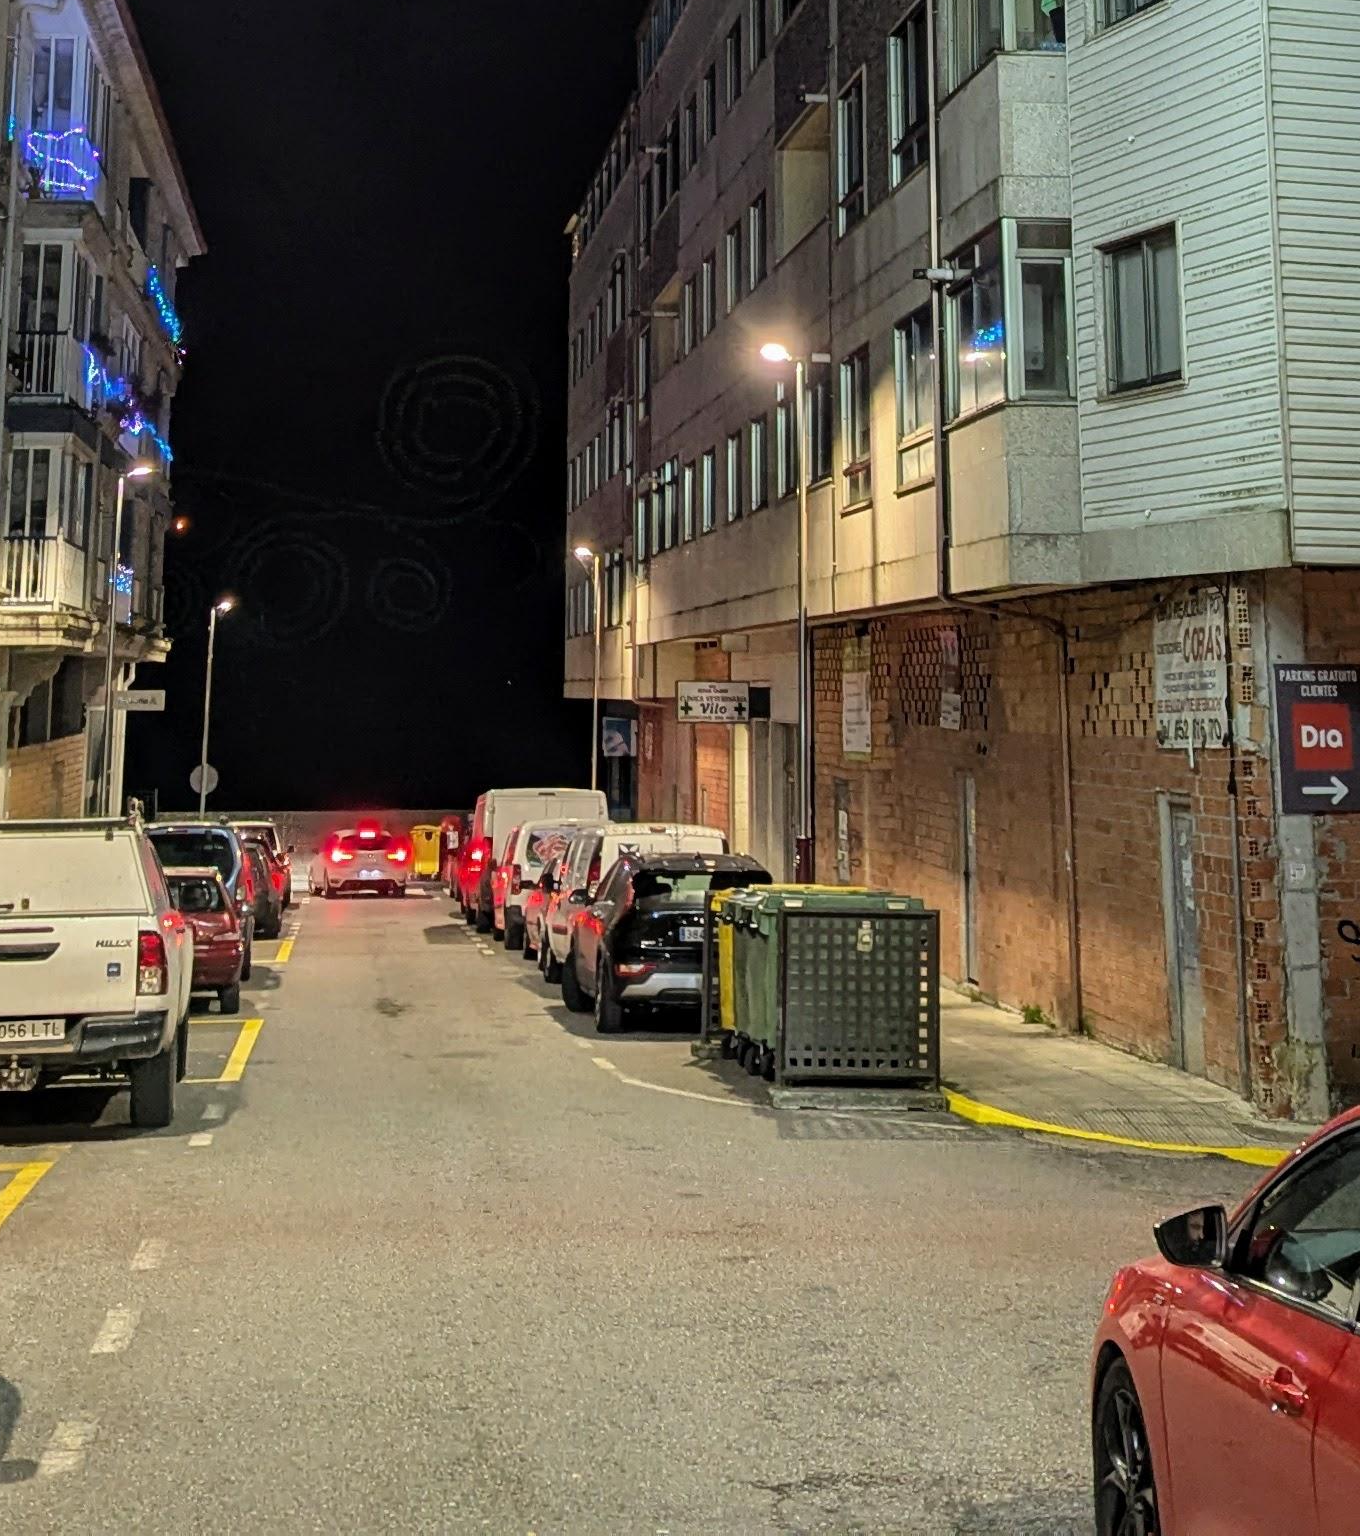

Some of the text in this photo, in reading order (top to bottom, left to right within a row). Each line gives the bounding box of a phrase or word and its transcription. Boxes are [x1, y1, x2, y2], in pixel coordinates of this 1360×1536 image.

[1279, 669, 1358, 682] PARKING GRATUITO
[1300, 685, 1338, 697] CLIENTES
[1300, 725, 1344, 748] Dia
[31, 1022, 61, 1037] LTL
